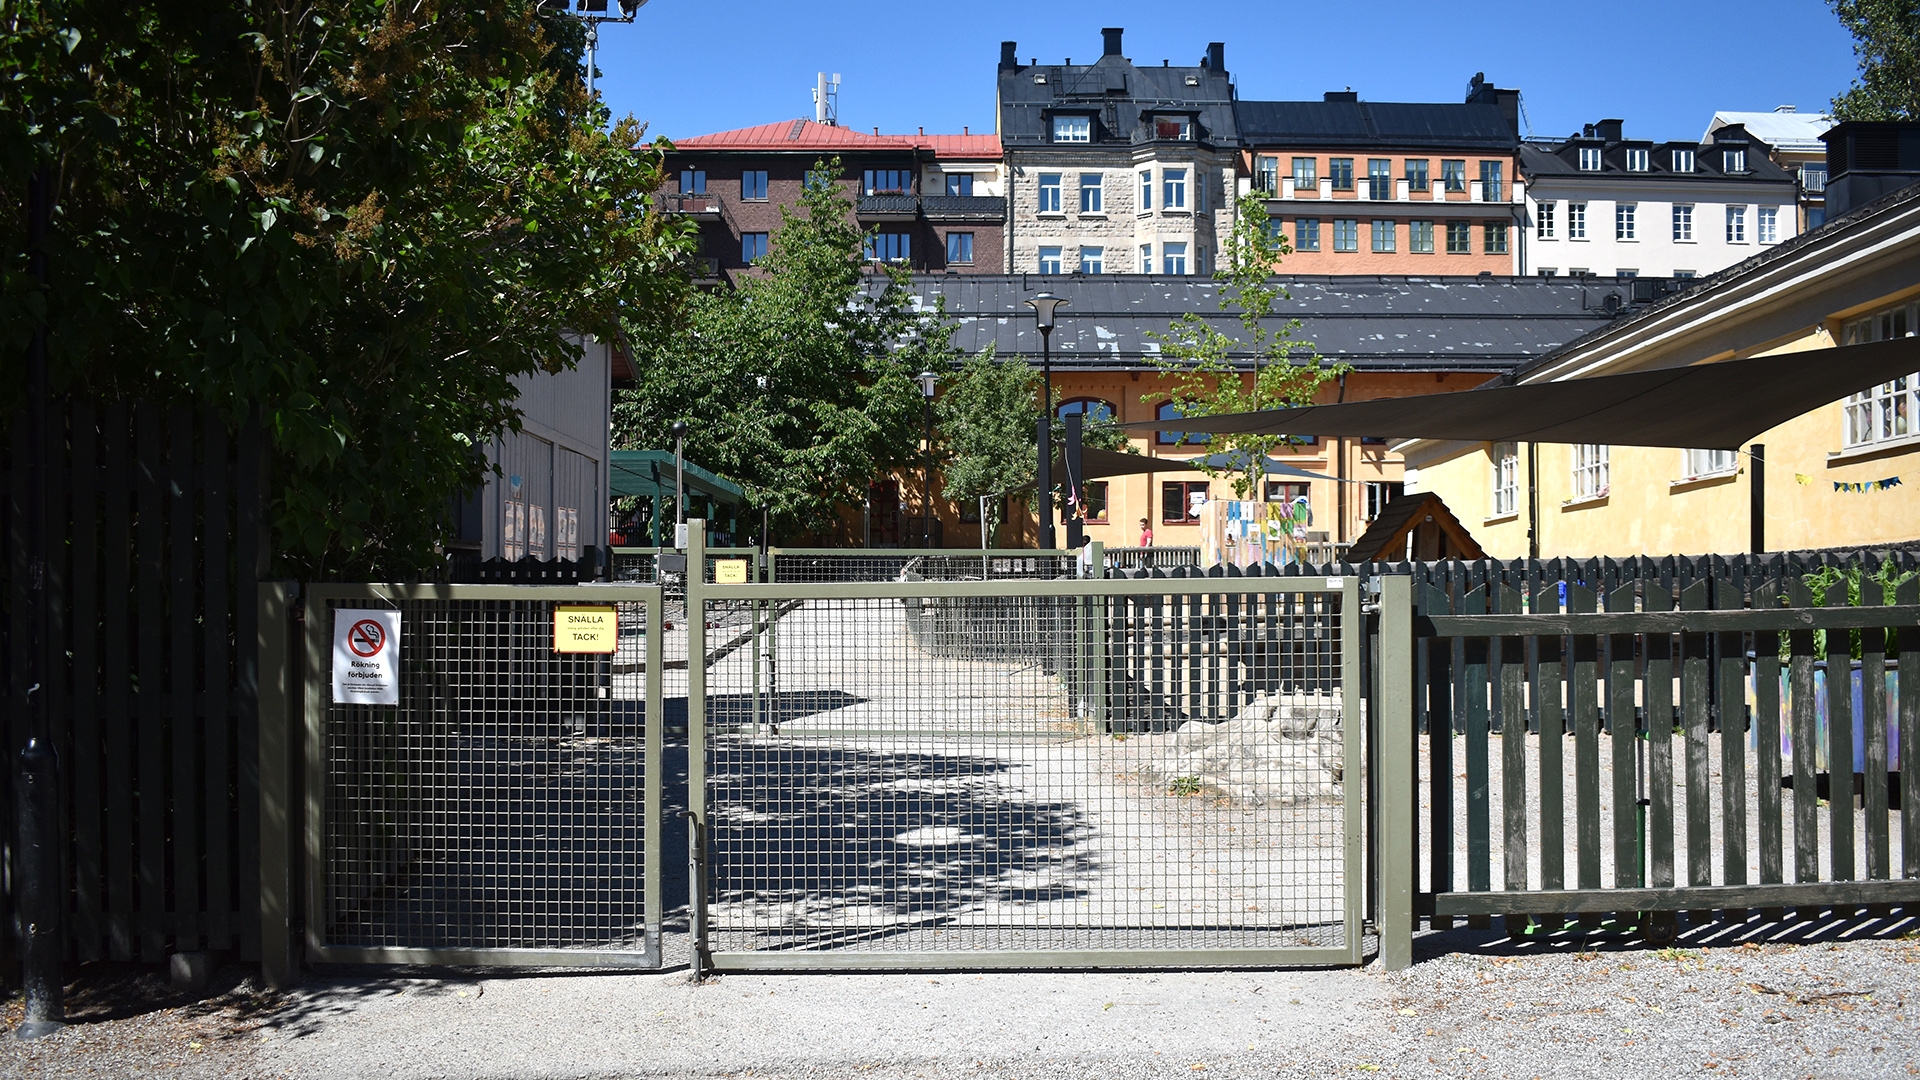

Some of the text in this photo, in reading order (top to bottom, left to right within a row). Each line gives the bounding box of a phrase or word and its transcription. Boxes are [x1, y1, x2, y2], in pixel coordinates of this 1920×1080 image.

[567, 614, 604, 623] SNÄLLA
[572, 633, 599, 641] TACK!
[351, 660, 380, 669] Rökning
[347, 671, 383, 679] förbjuden
